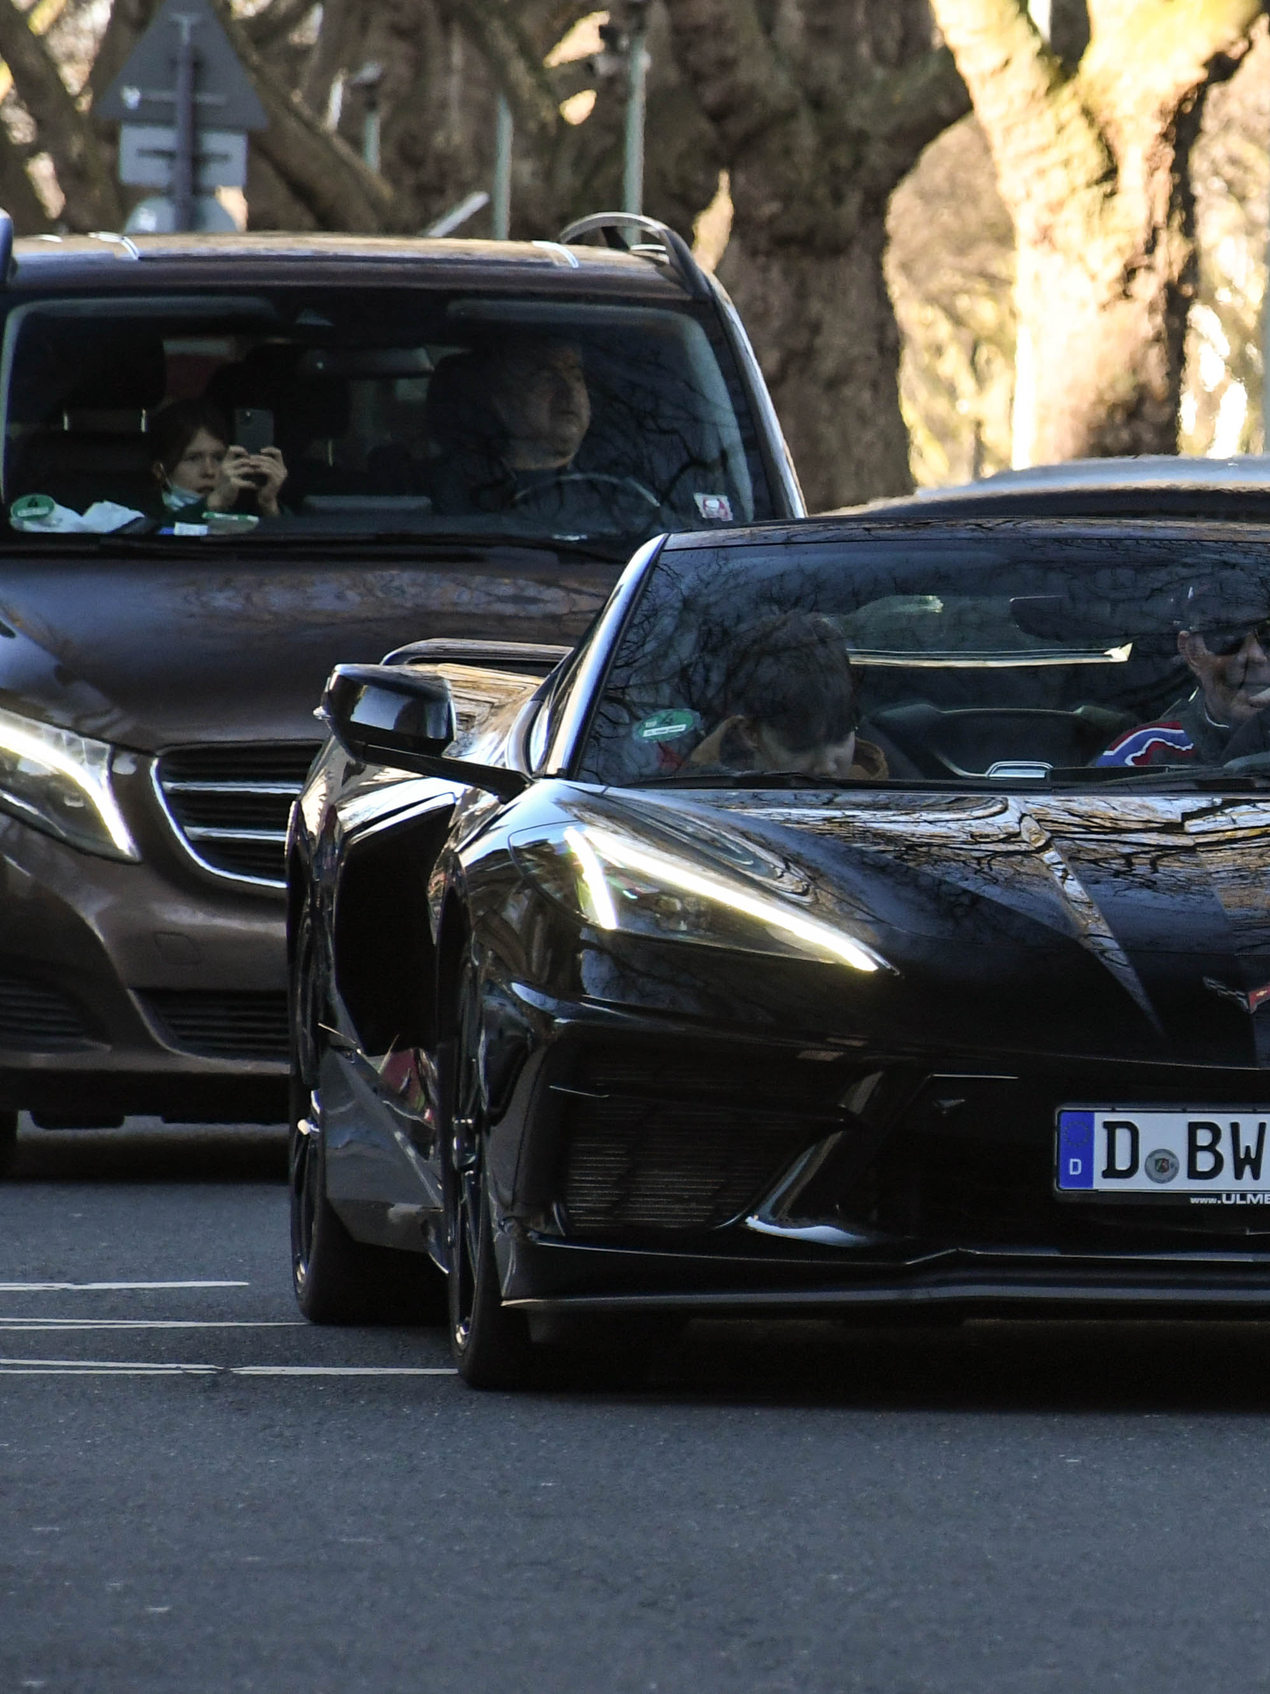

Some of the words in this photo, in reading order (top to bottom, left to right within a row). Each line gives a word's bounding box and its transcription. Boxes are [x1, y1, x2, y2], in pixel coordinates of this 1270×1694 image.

[1069, 1158, 1082, 1175] D
[1101, 1120, 1140, 1180] D
[1187, 1121, 1267, 1181] BW
